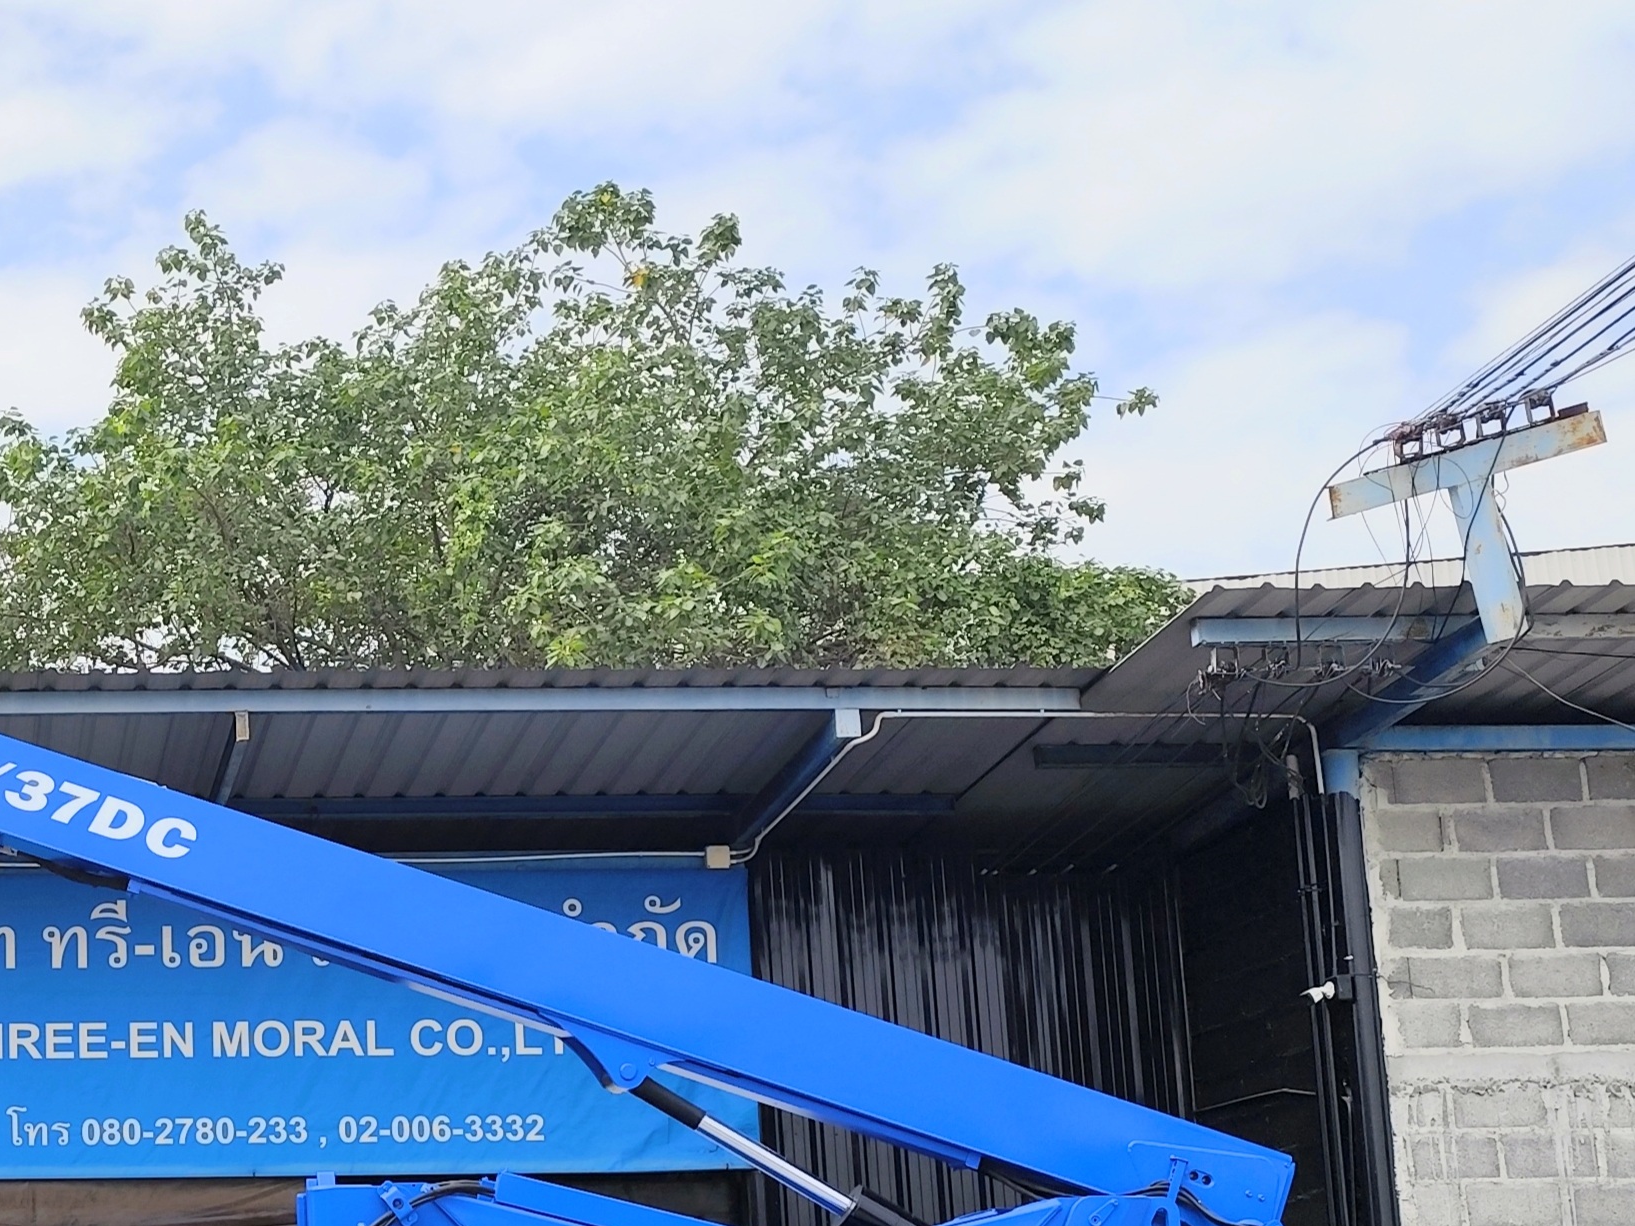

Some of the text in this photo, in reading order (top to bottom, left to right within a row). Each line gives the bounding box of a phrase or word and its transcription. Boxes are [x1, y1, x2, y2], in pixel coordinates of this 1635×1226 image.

[211, 1019, 395, 1058] MORAL
[6, 1107, 70, 1146] โทร
[81, 1116, 309, 1146] 080-2780-233
[338, 1114, 546, 1143] 02-006-3332
